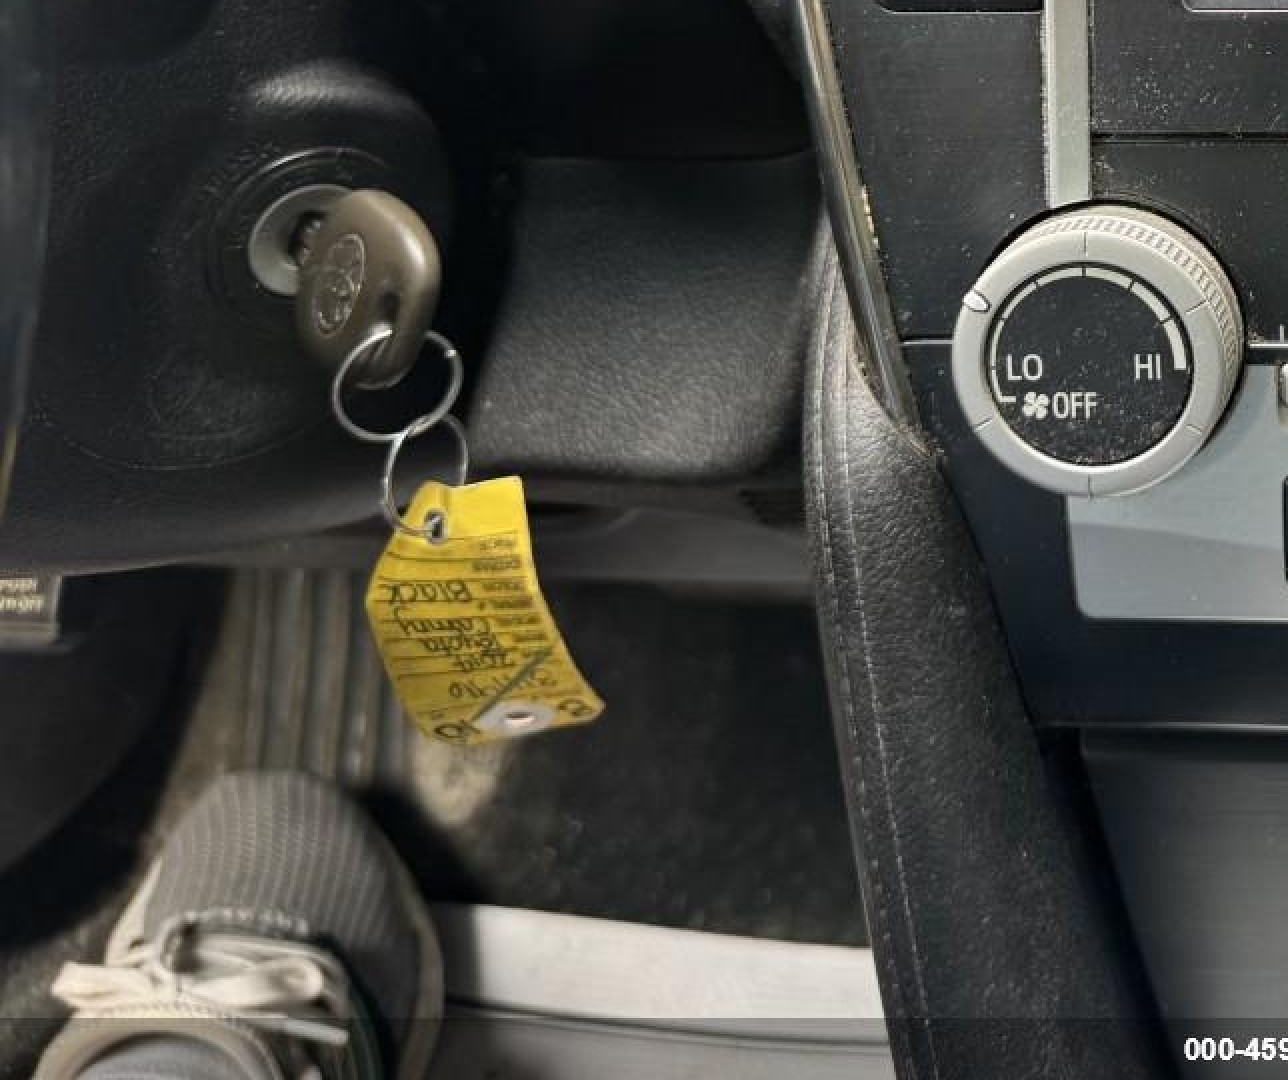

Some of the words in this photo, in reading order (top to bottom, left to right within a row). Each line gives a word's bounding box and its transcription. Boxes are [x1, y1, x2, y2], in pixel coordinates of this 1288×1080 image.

[1006, 353, 1043, 381] LO
[1133, 353, 1163, 382] HI
[1053, 391, 1099, 420] OFF
